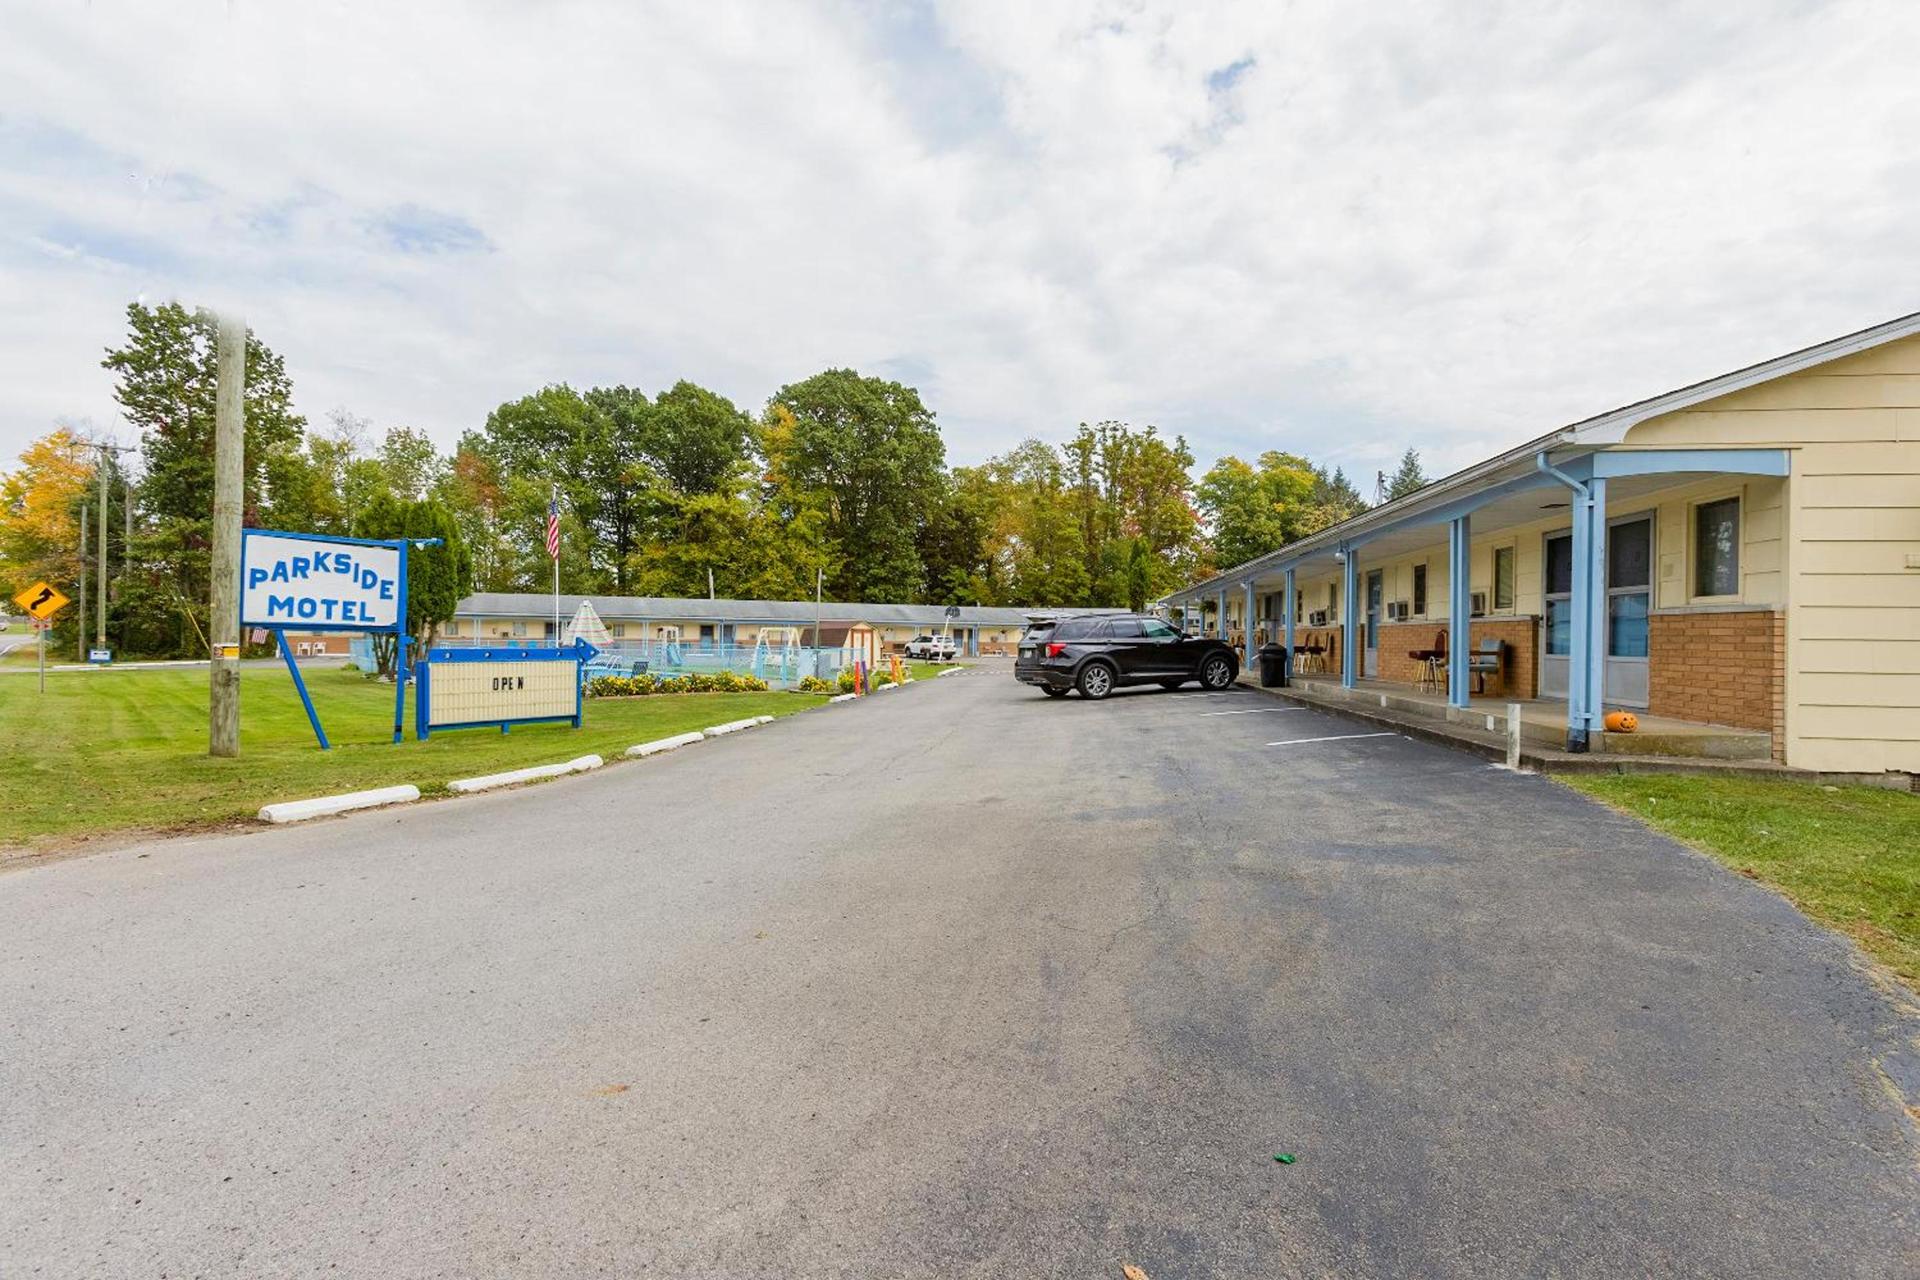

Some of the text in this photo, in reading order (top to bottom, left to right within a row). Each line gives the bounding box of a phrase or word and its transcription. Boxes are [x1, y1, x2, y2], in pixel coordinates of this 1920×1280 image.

[249, 551, 394, 600] PARKSIDE
[267, 595, 376, 623] MOTEL
[492, 676, 524, 691] OPEN
